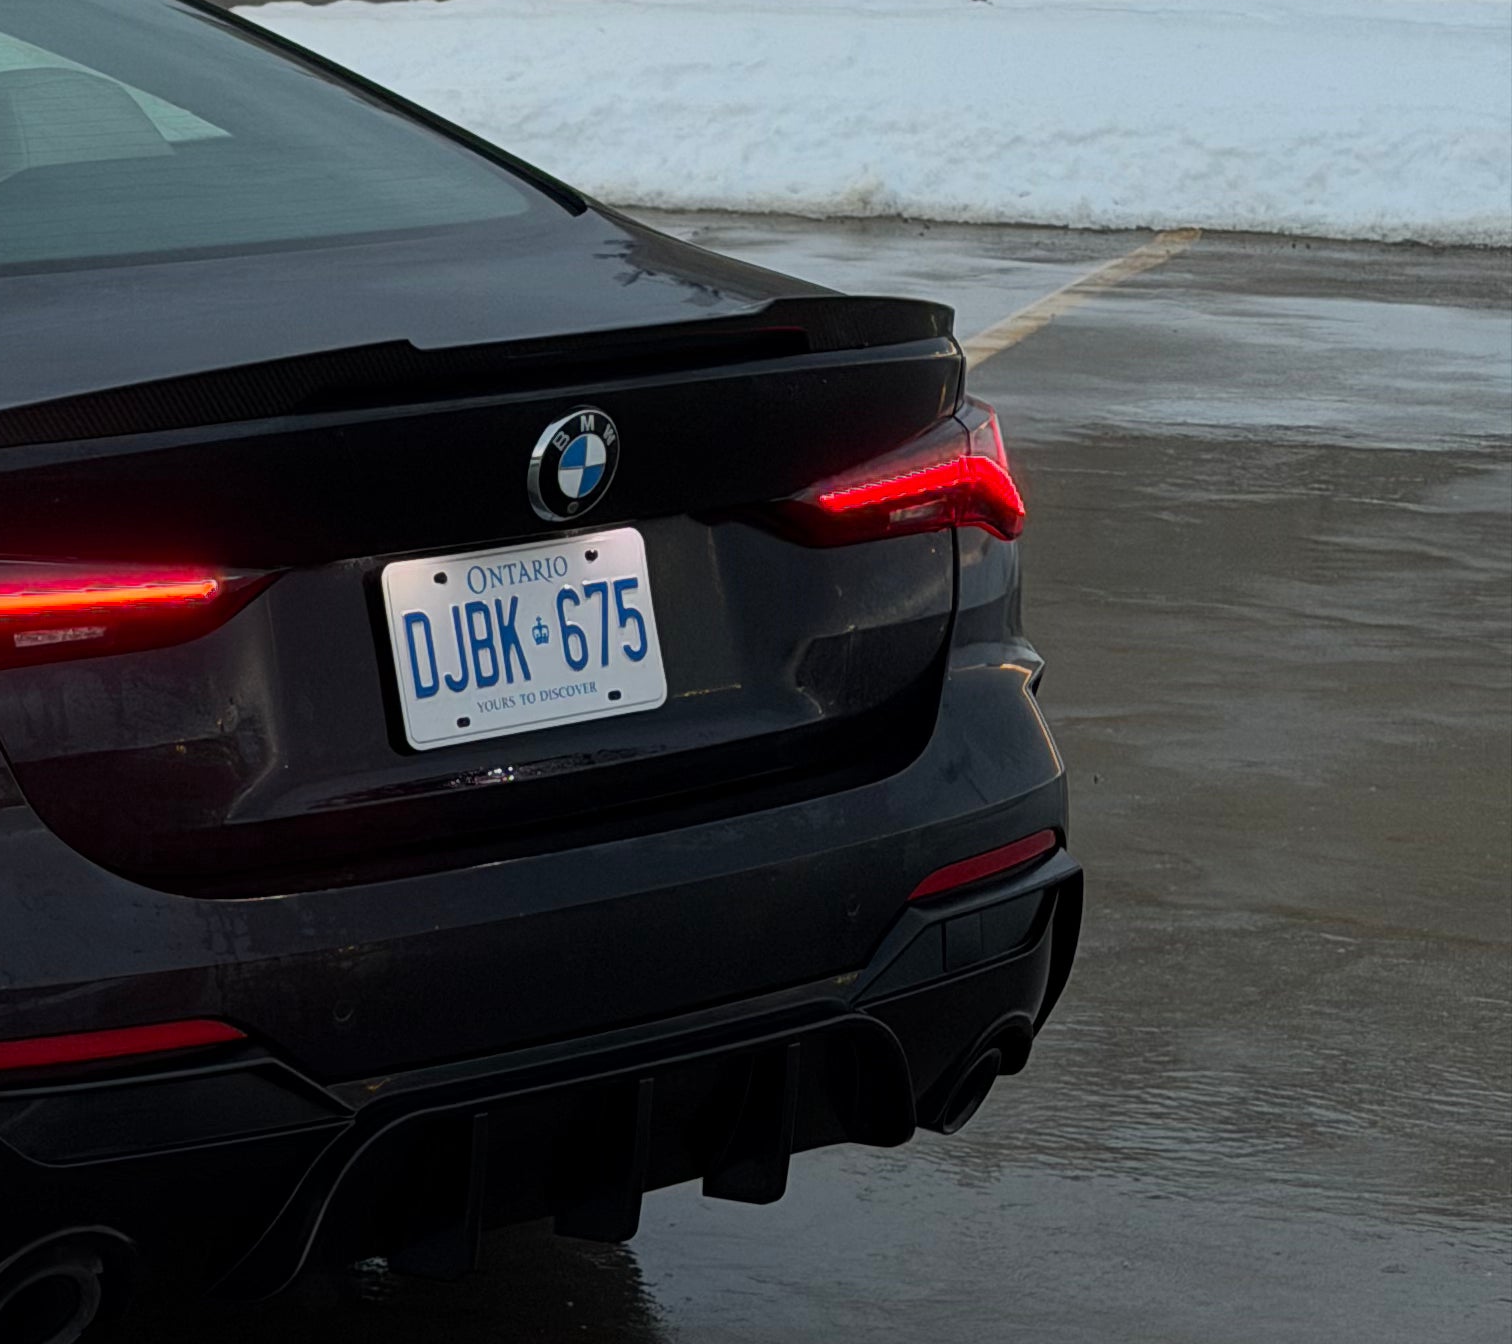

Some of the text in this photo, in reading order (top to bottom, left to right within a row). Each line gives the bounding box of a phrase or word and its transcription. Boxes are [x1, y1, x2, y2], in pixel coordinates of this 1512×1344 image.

[552, 414, 616, 452] BMW
[467, 556, 568, 594] ONTARIO
[403, 577, 648, 699] DJBK 675
[476, 681, 598, 713] YOURS TO DISCOVER
